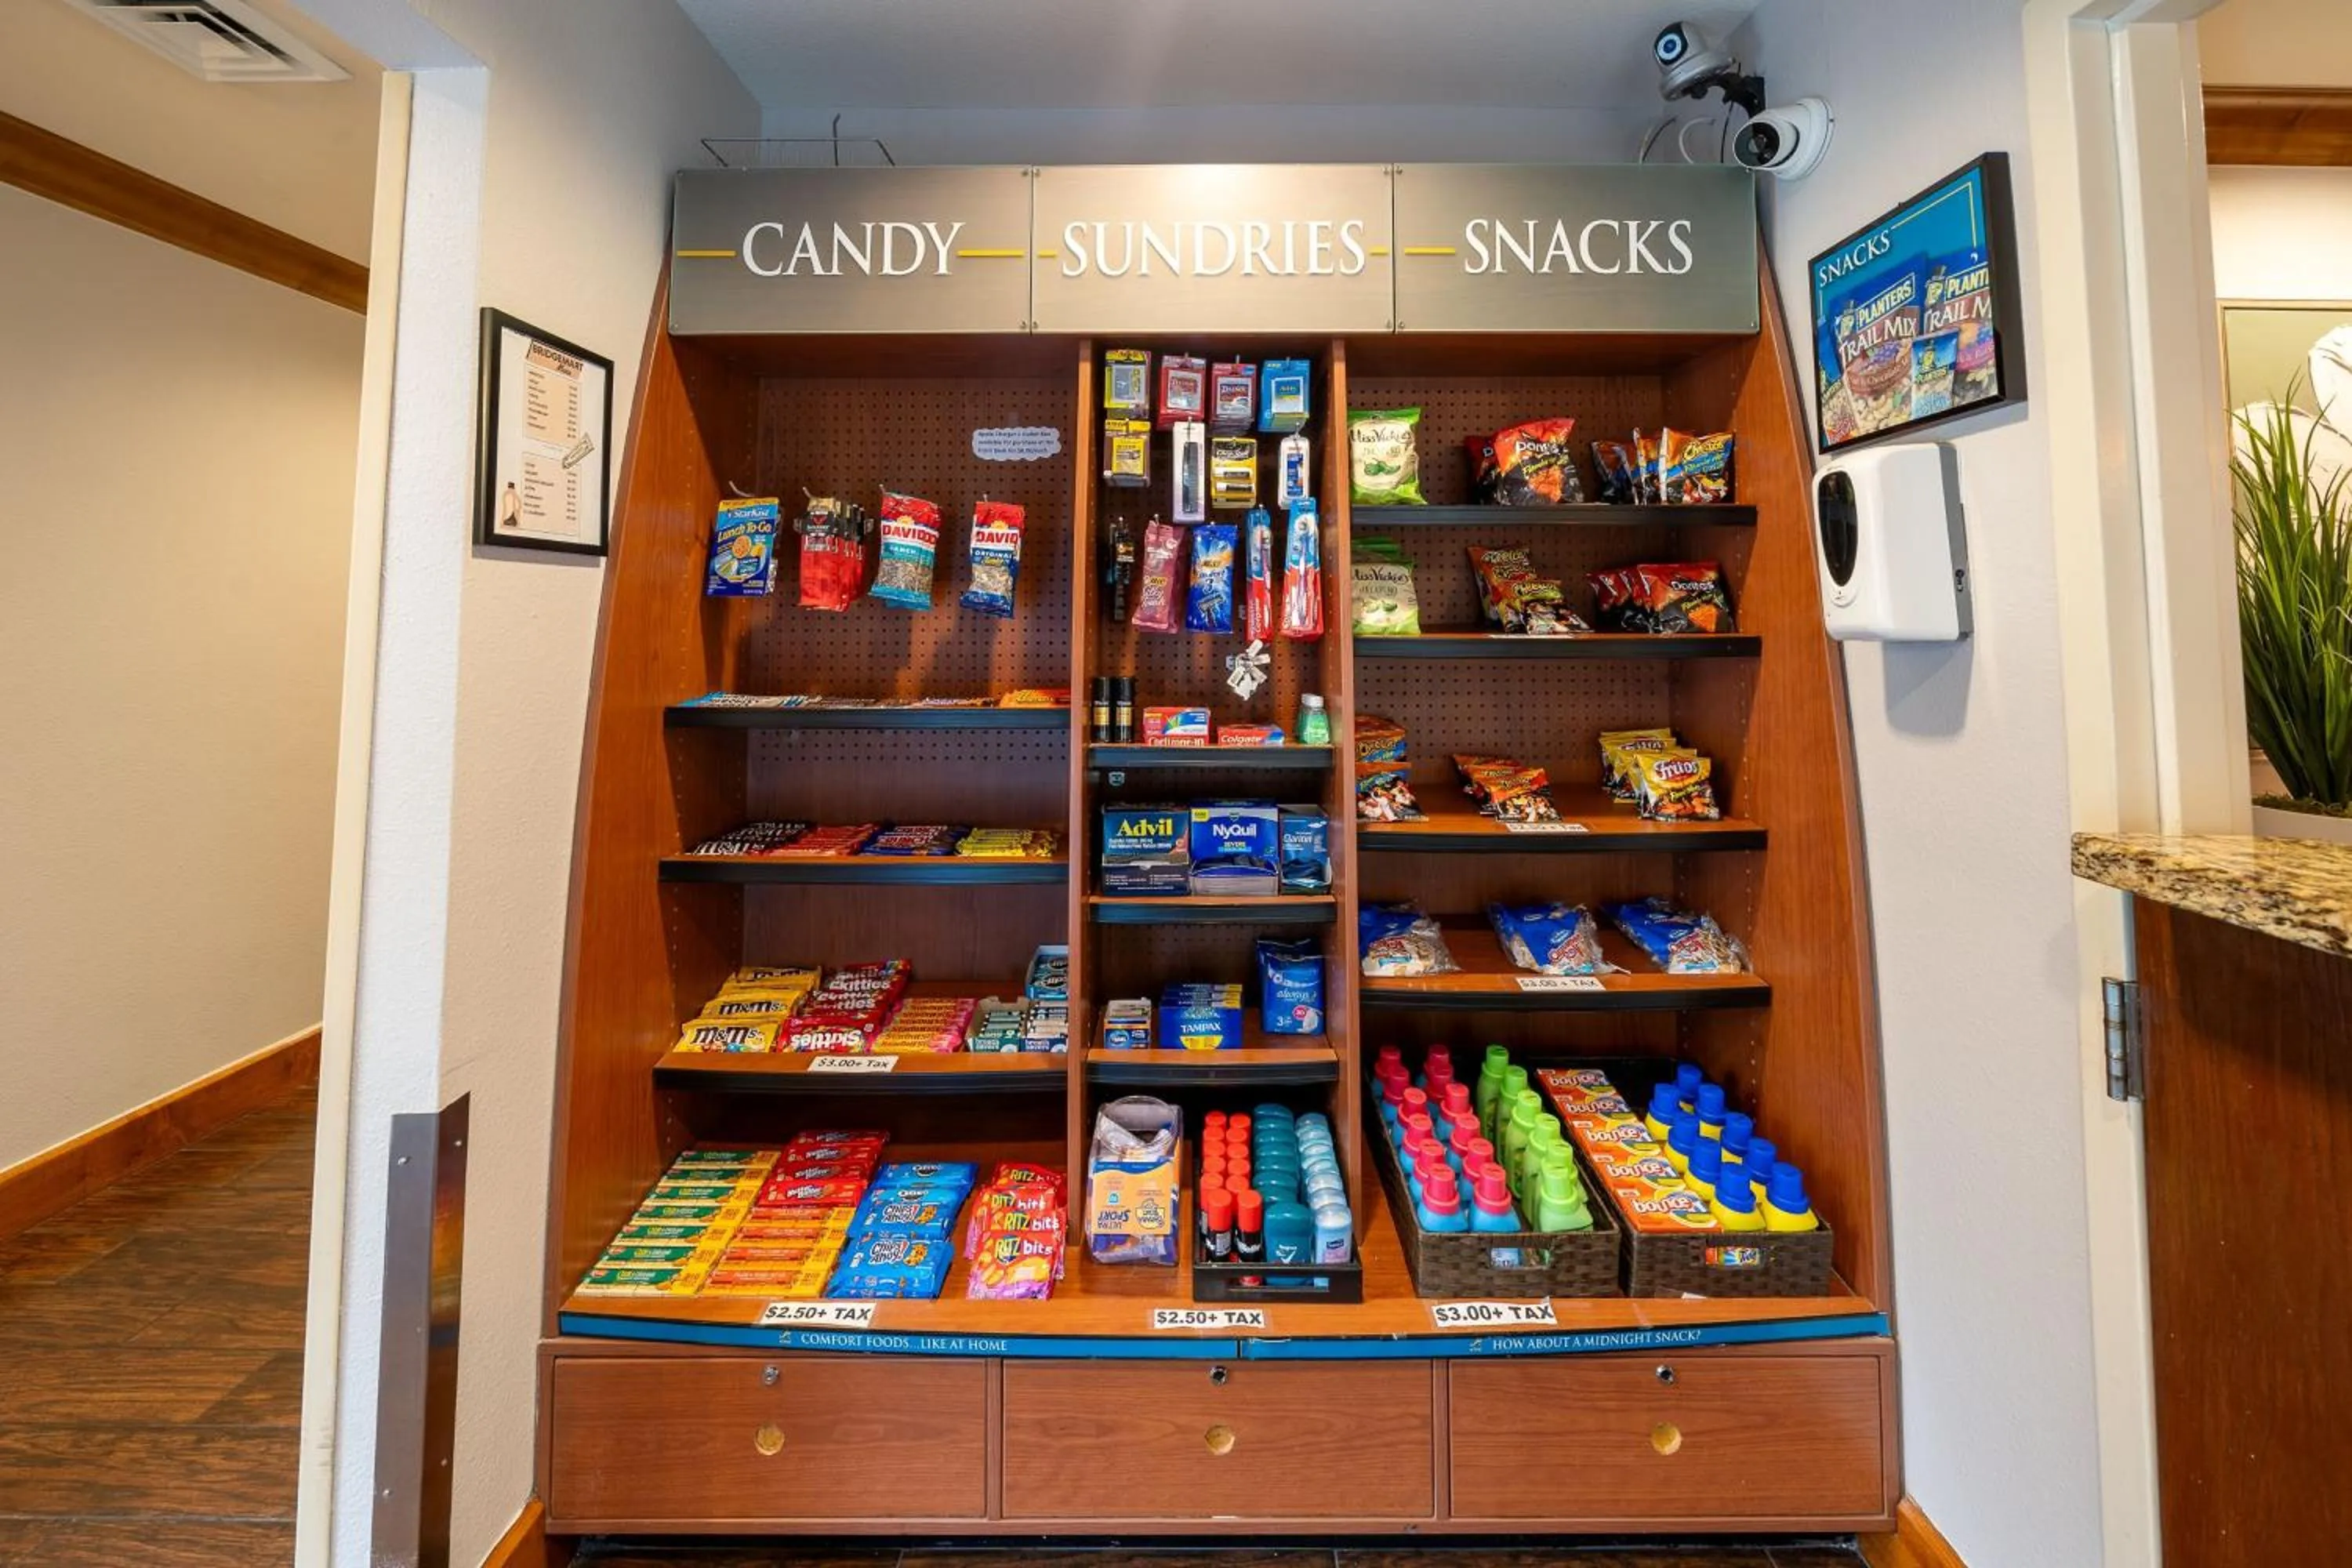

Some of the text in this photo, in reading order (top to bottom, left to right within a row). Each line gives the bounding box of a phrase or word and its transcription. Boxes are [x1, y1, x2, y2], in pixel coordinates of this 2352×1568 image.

[742, 221, 966, 278] CANDY
[1061, 219, 1367, 278] SUNDRIES
[1462, 218, 1693, 276] SNACKS
[1819, 229, 1892, 288] SNACKS
[1859, 280, 1912, 327] PLANTERS
[1925, 299, 1969, 332] TRAIL
[1839, 315, 1917, 362] TRAIL MIX
[533, 344, 583, 372] BRIDGEMART
[717, 524, 746, 543] Lunch
[976, 531, 1018, 544] DAVID
[1116, 818, 1174, 837] Advil
[1213, 823, 1257, 839] NyQuil
[1180, 1022, 1222, 1033] TAMPAX
[790, 1029, 862, 1050] Skittles
[818, 1058, 890, 1068] $3.00+ Tax
[1586, 1127, 1639, 1143] bounce
[1606, 1161, 1661, 1178] bounce
[1631, 1196, 1690, 1214] bounce
[1004, 1212, 1030, 1230] RITZ
[1098, 1209, 1131, 1222] SPORT
[995, 1236, 1053, 1258] RITZ bits
[764, 1305, 873, 1321] $2.50+ TAX
[1156, 1310, 1262, 1325] $2.50+ TAX
[1436, 1305, 1554, 1322] $3.00+ TAX
[800, 1333, 862, 1347] COMFORT
[949, 1338, 965, 1350] AT
[969, 1340, 1007, 1352] HOME
[1493, 1330, 1701, 1350] HOW ABOUT A MIDNIGHT SNACK?
